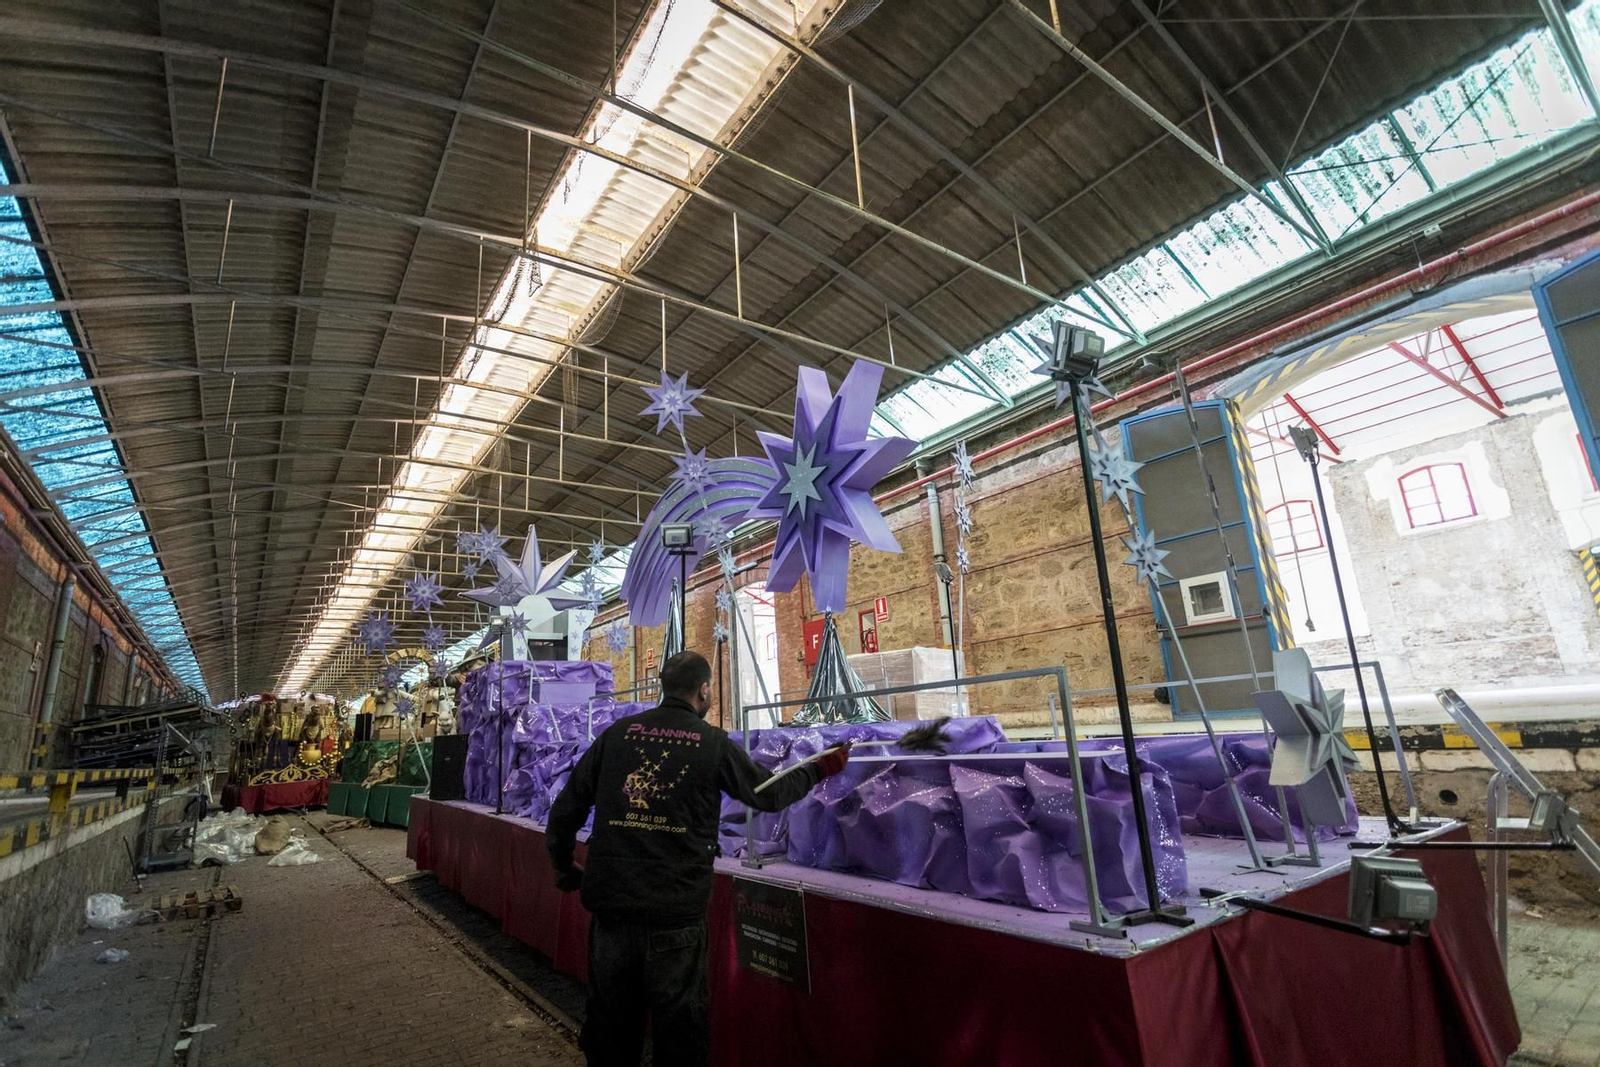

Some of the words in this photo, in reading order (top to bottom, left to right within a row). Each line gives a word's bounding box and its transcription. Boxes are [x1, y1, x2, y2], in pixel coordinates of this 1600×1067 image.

[812, 634, 819, 649] F
[625, 812, 638, 820] 607
[640, 814, 652, 822] 361
